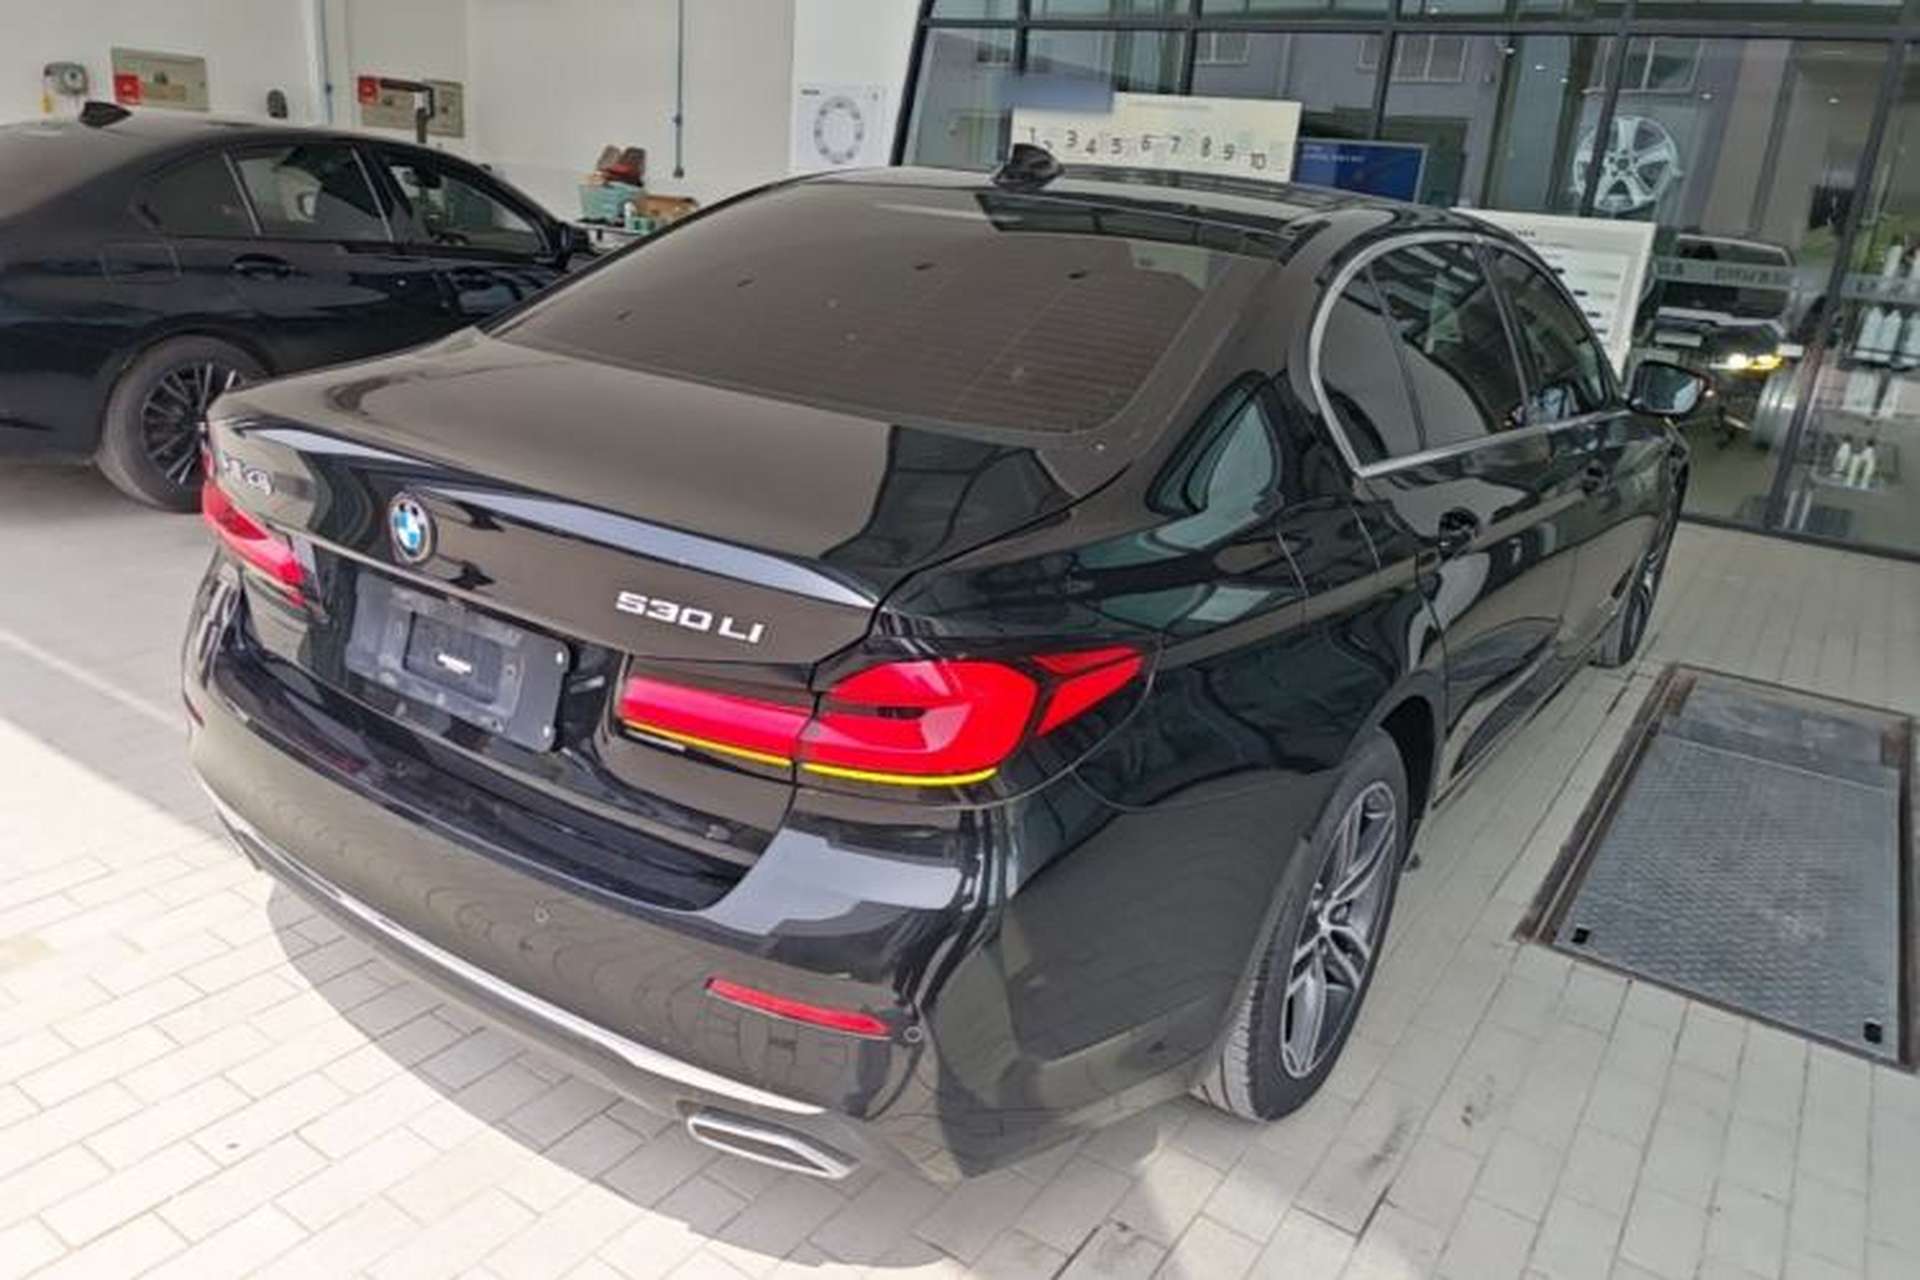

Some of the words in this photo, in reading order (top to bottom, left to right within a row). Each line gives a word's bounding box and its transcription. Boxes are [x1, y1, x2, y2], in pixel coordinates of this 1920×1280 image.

[1066, 129, 1078, 148] 3
[1085, 138, 1096, 155] 4
[1111, 137, 1122, 155] 5
[1141, 134, 1152, 151] 6
[1169, 135, 1181, 152] 7
[1201, 135, 1212, 158] 8
[1223, 143, 1235, 161] 9
[1248, 152, 1267, 170] 10
[615, 591, 713, 632] 530
